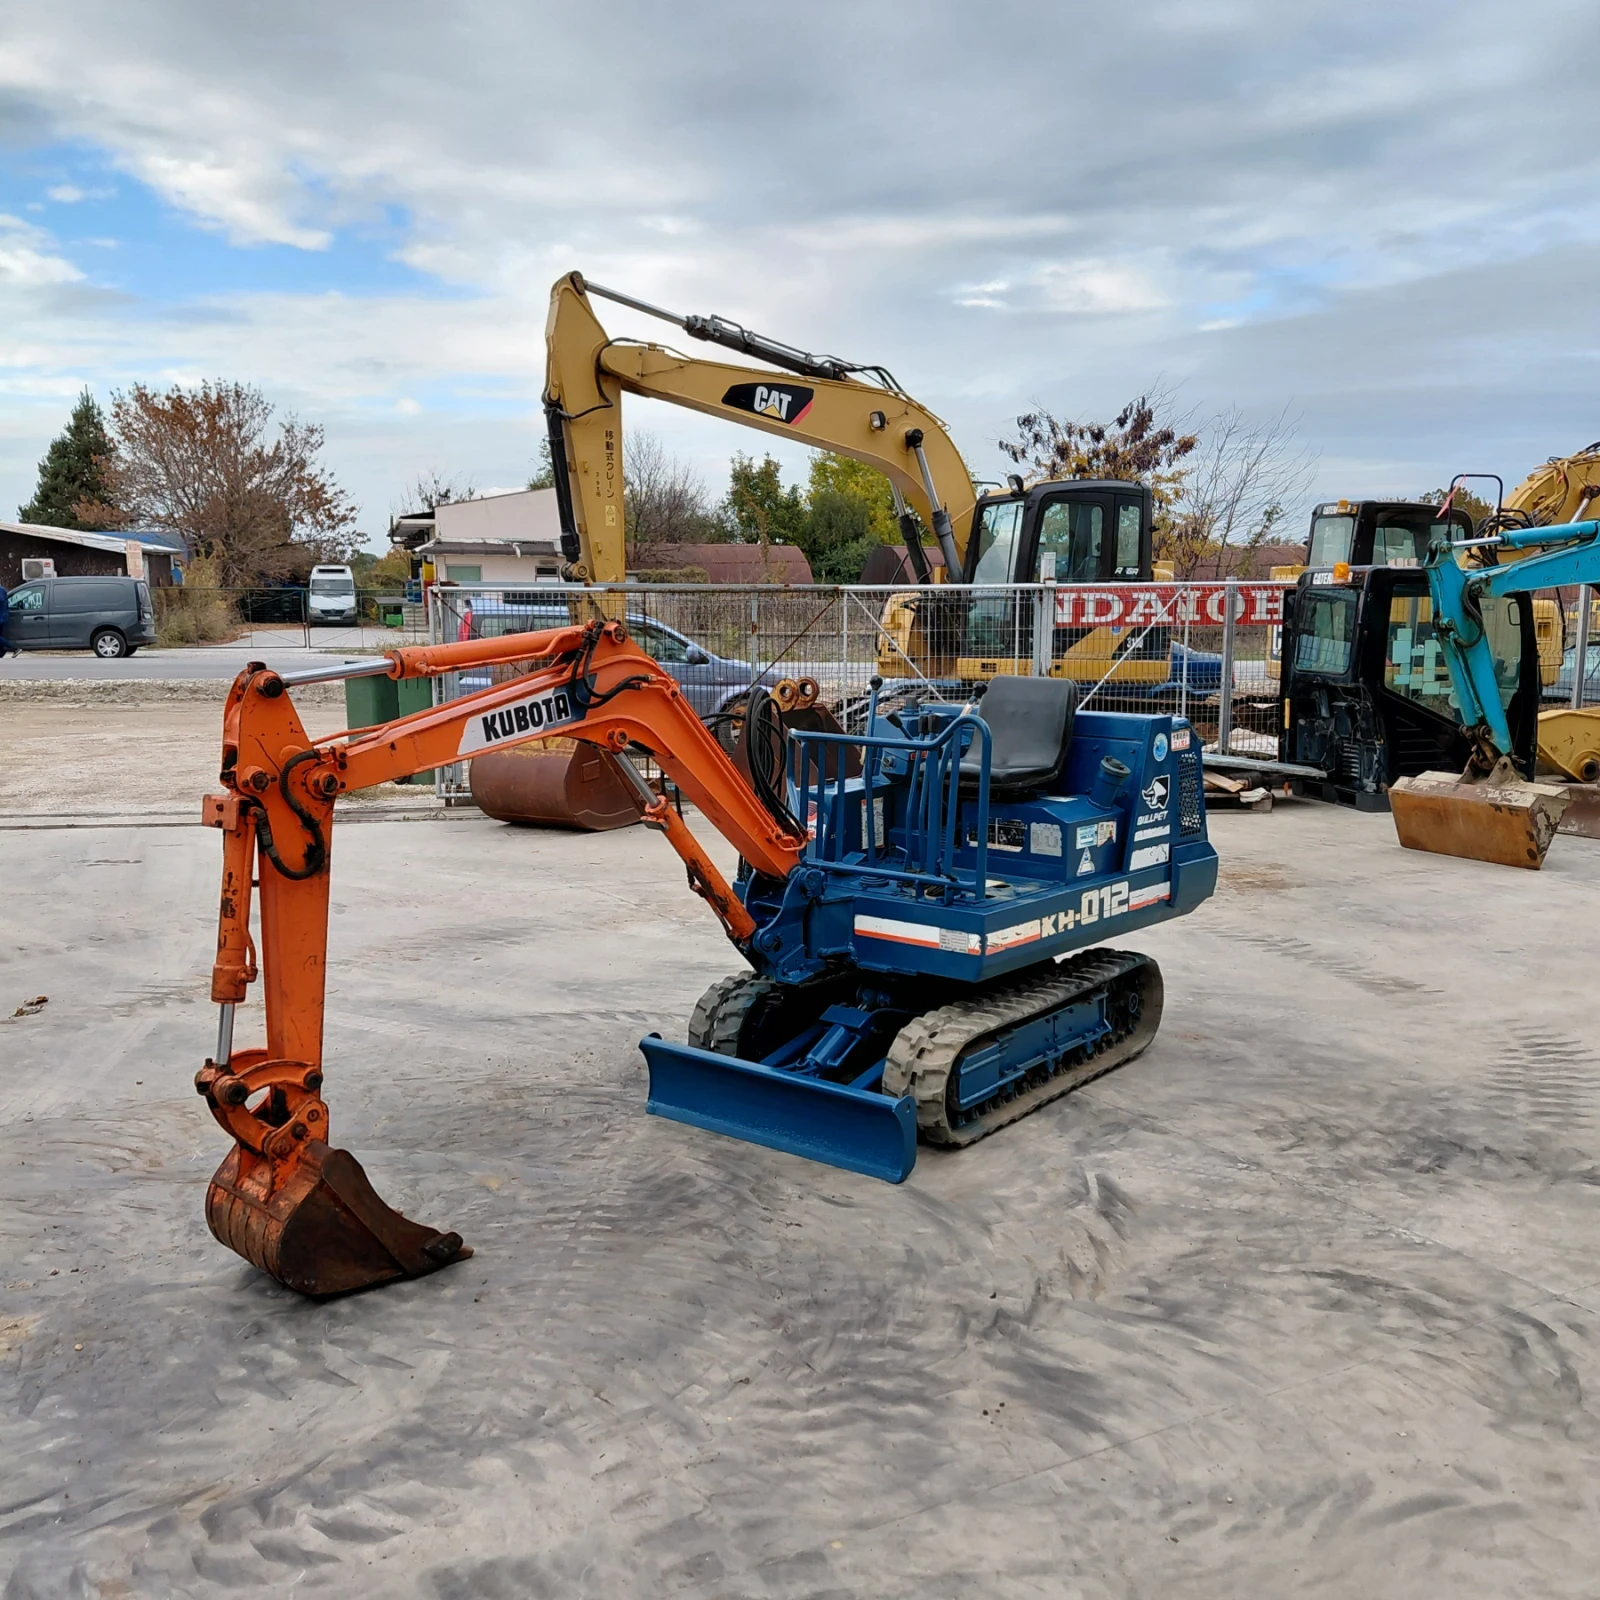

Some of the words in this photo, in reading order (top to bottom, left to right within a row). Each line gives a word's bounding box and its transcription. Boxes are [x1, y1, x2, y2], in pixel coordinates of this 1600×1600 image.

[753, 385, 793, 421] CAT
[605, 429, 615, 499] 移動式クレーン
[482, 692, 571, 742] KUBOTA
[1041, 880, 1129, 938] KH-012
